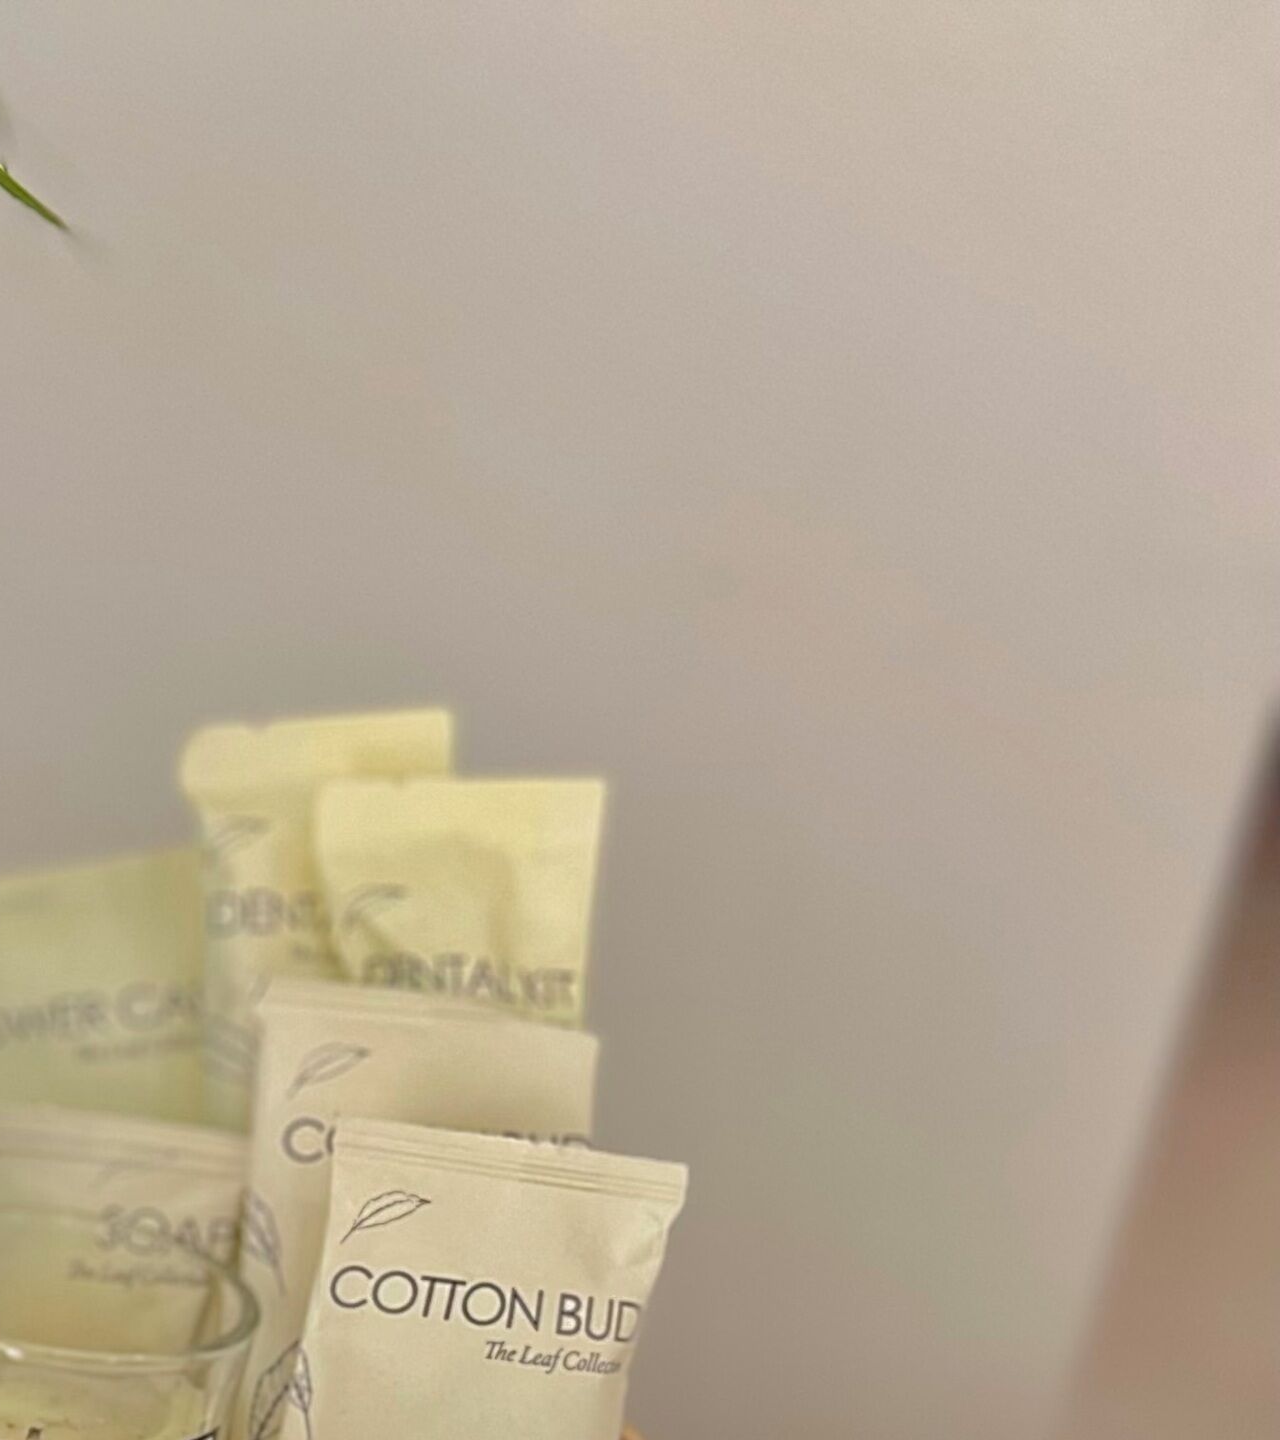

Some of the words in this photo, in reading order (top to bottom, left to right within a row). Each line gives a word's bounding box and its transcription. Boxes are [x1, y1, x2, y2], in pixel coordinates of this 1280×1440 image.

[114, 980, 205, 1031] CA
[330, 1265, 544, 1332] COTTON
[485, 1340, 517, 1362] The
[519, 1345, 563, 1375] Leaf
